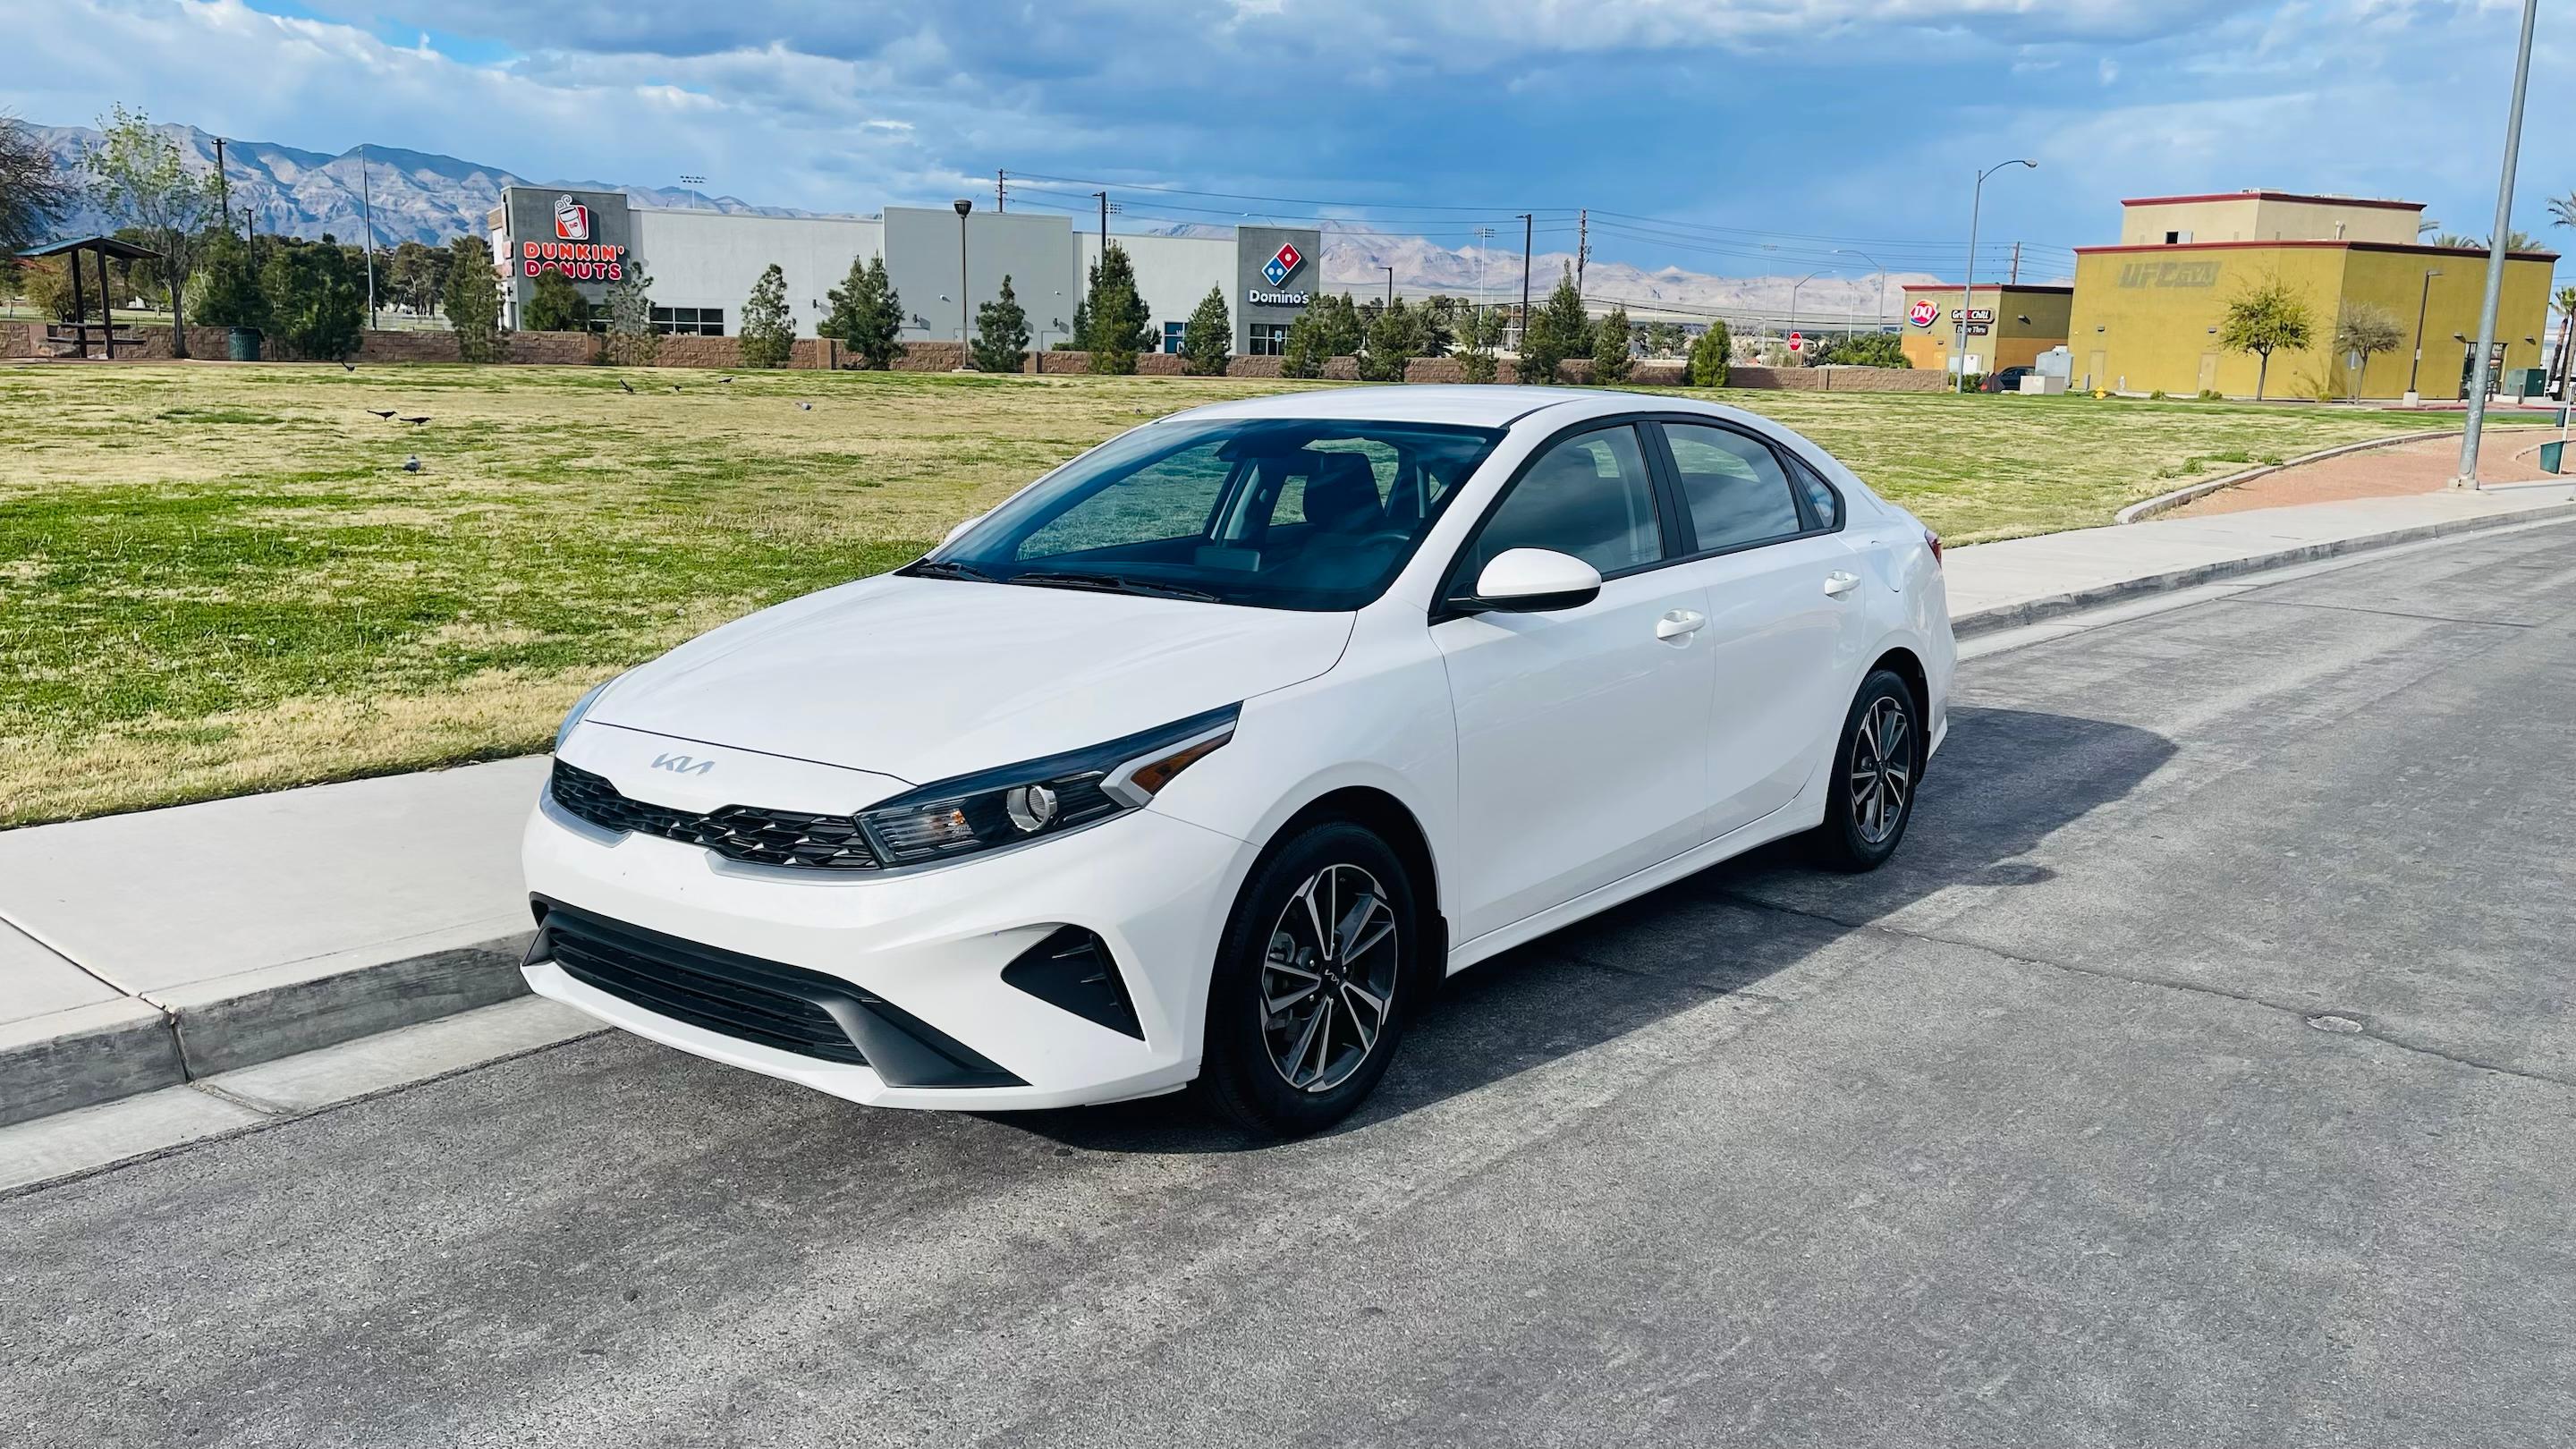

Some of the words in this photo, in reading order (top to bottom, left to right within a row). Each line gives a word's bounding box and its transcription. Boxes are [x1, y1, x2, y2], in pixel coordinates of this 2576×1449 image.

[523, 242, 624, 261] DUNKIN'
[1249, 289, 1309, 304] Domino's
[1914, 305, 1932, 318] DQ
[650, 752, 716, 775] KIA
